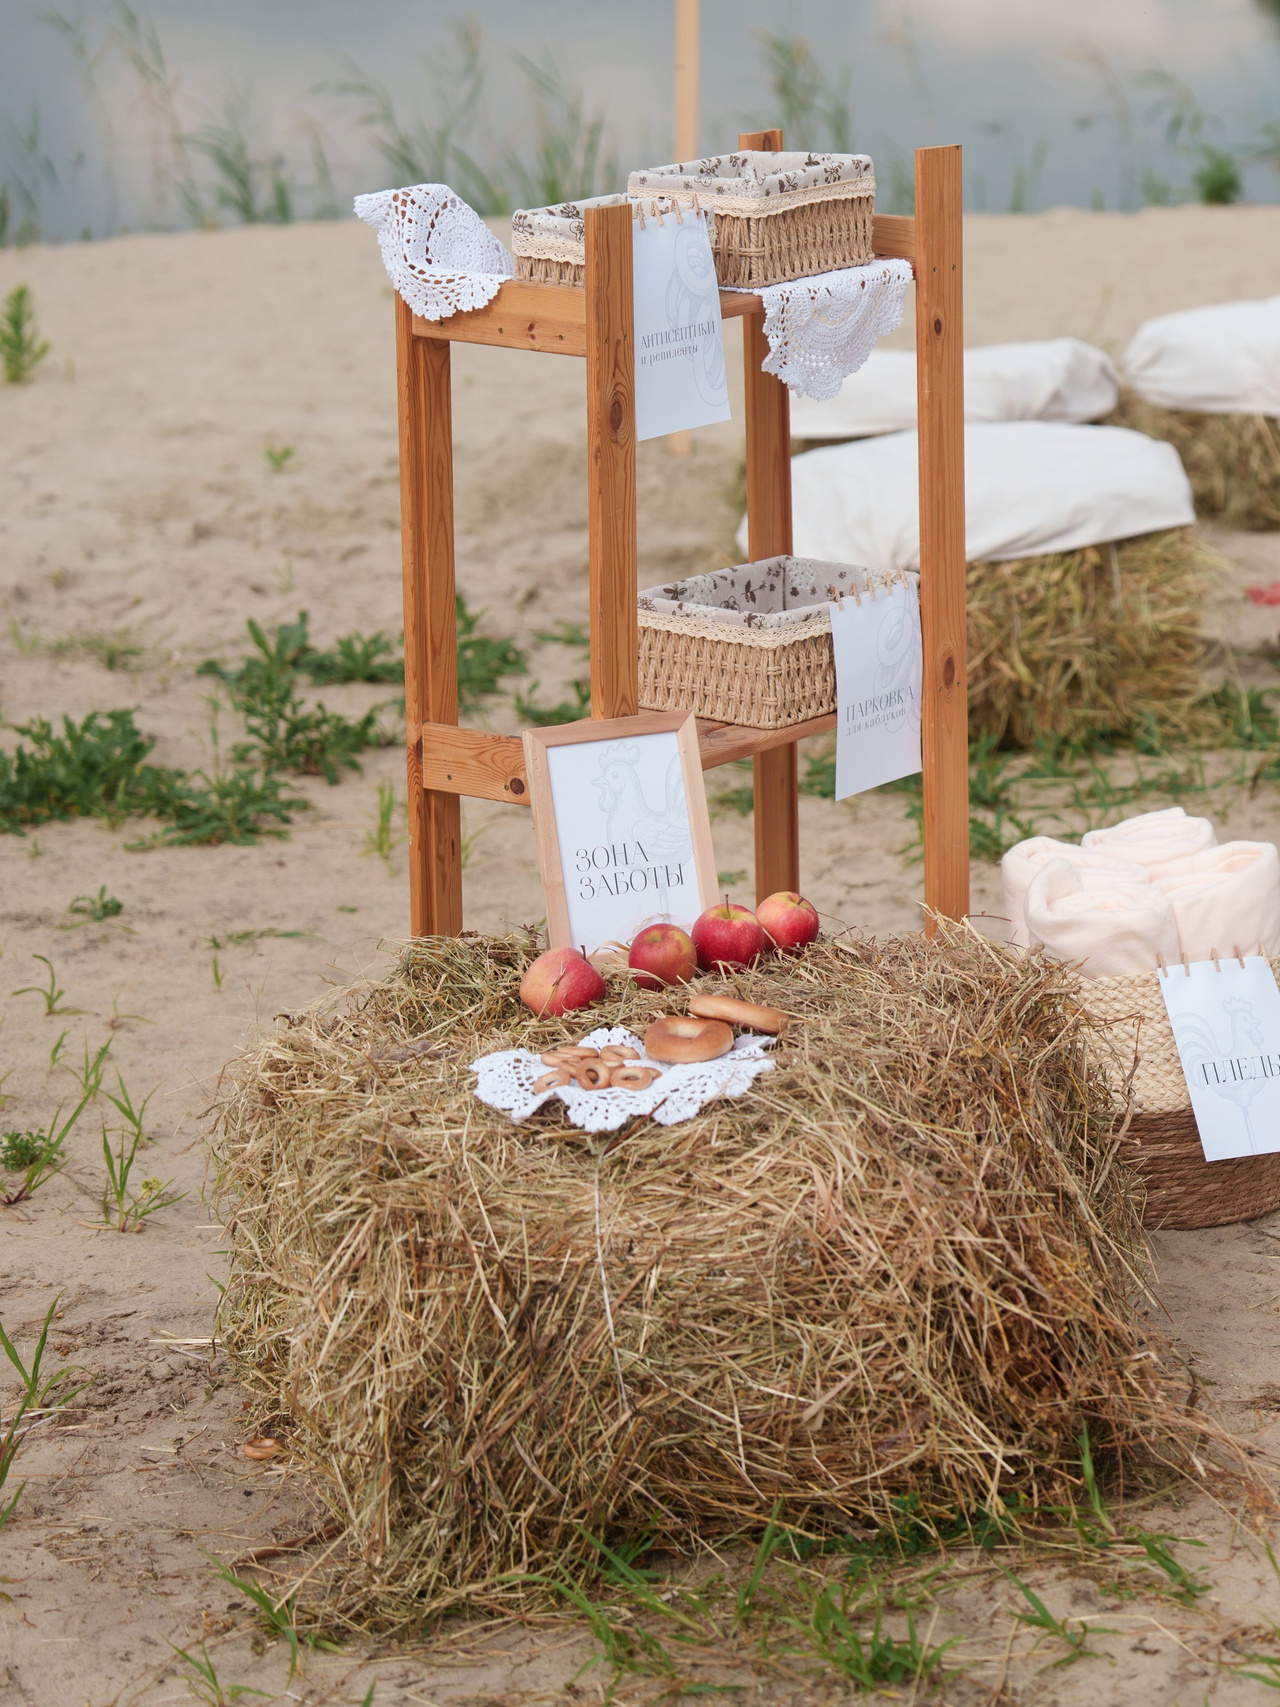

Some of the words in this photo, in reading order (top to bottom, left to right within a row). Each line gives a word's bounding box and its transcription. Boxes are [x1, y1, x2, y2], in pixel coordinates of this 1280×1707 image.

[640, 321, 715, 349] АНТИСЕПТИКИ
[640, 356, 647, 365] и
[649, 344, 698, 366] репиленты
[846, 686, 914, 722] ПАРКОВКА
[846, 723, 862, 736] для
[865, 708, 906, 729] каблуков
[576, 841, 649, 872] ЗОНА
[579, 863, 685, 900] ЗАБОТЫ
